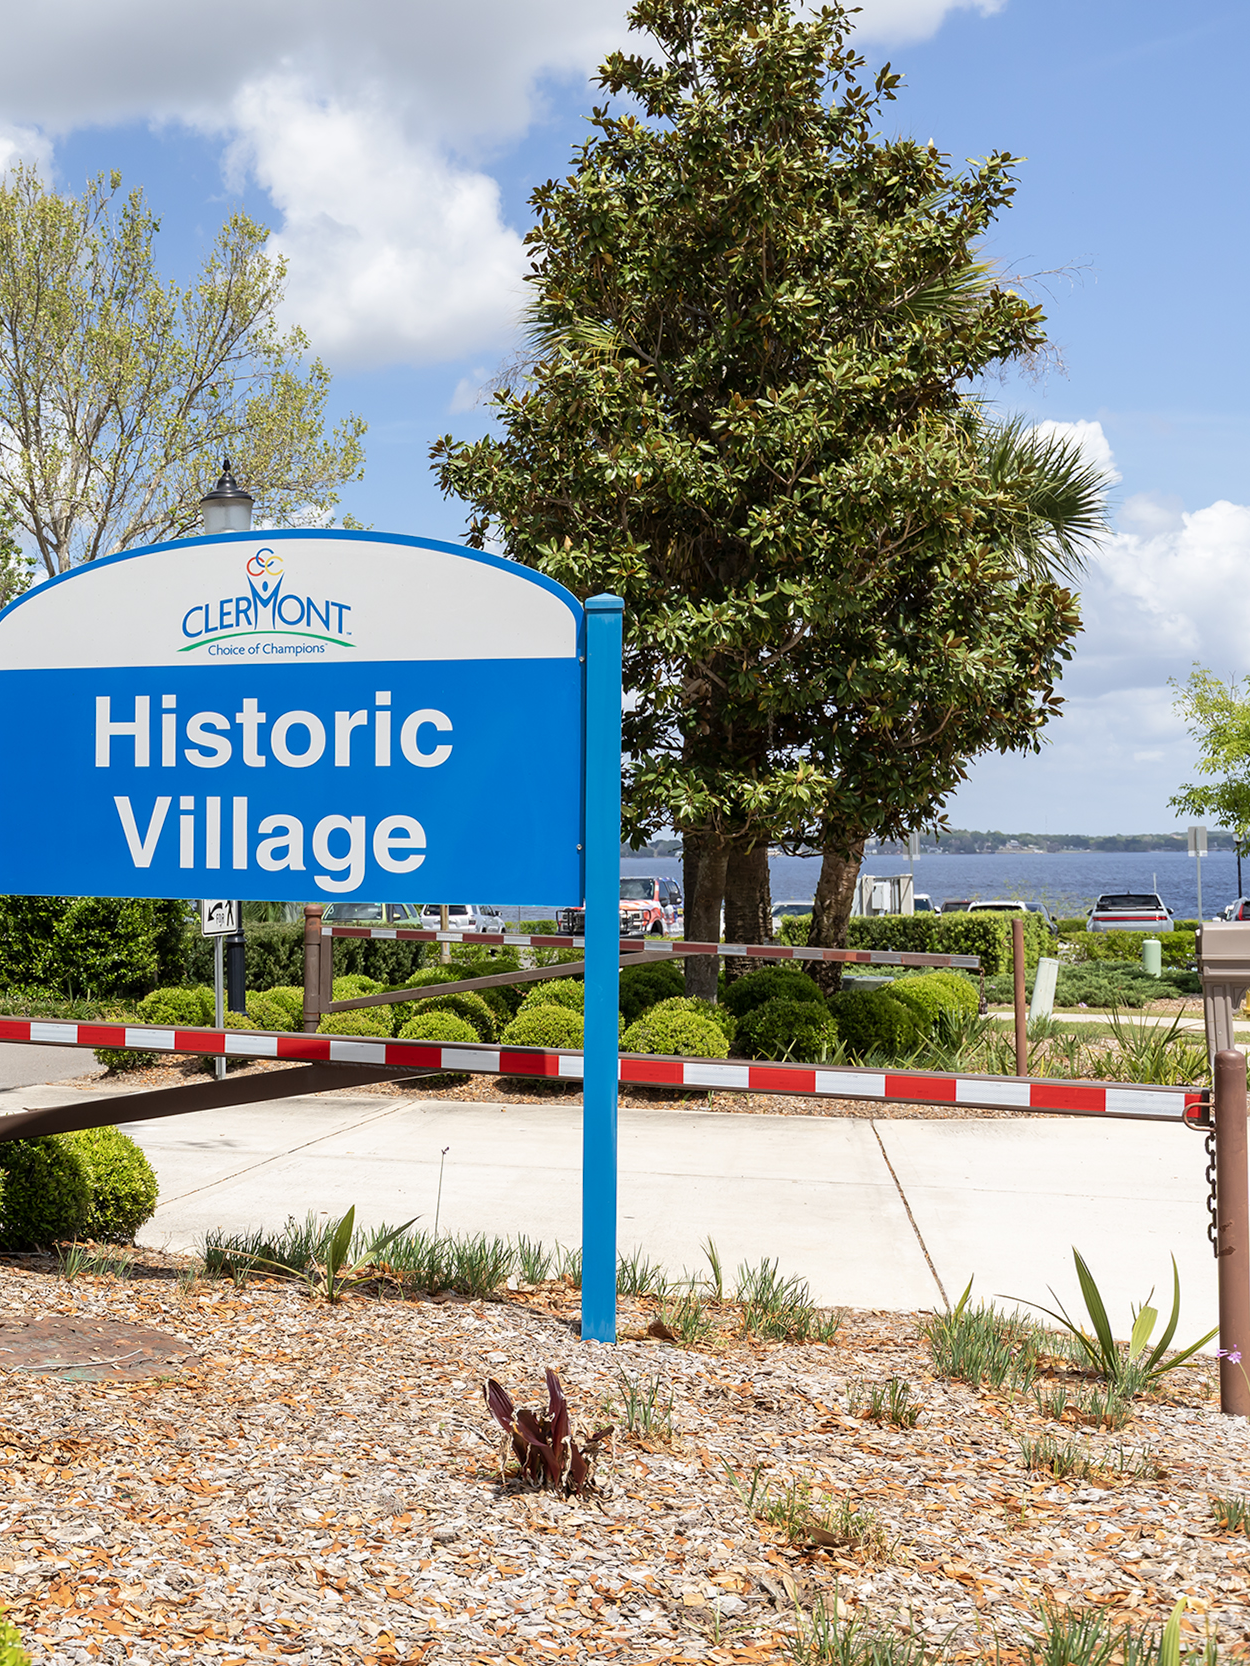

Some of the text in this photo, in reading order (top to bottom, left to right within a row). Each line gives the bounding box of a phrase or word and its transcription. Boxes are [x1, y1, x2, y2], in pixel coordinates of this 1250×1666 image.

[182, 572, 352, 638] CLERMONT
[208, 643, 326, 657] Choice of Champions
[95, 690, 454, 769] Historic
[113, 795, 427, 894] Village
